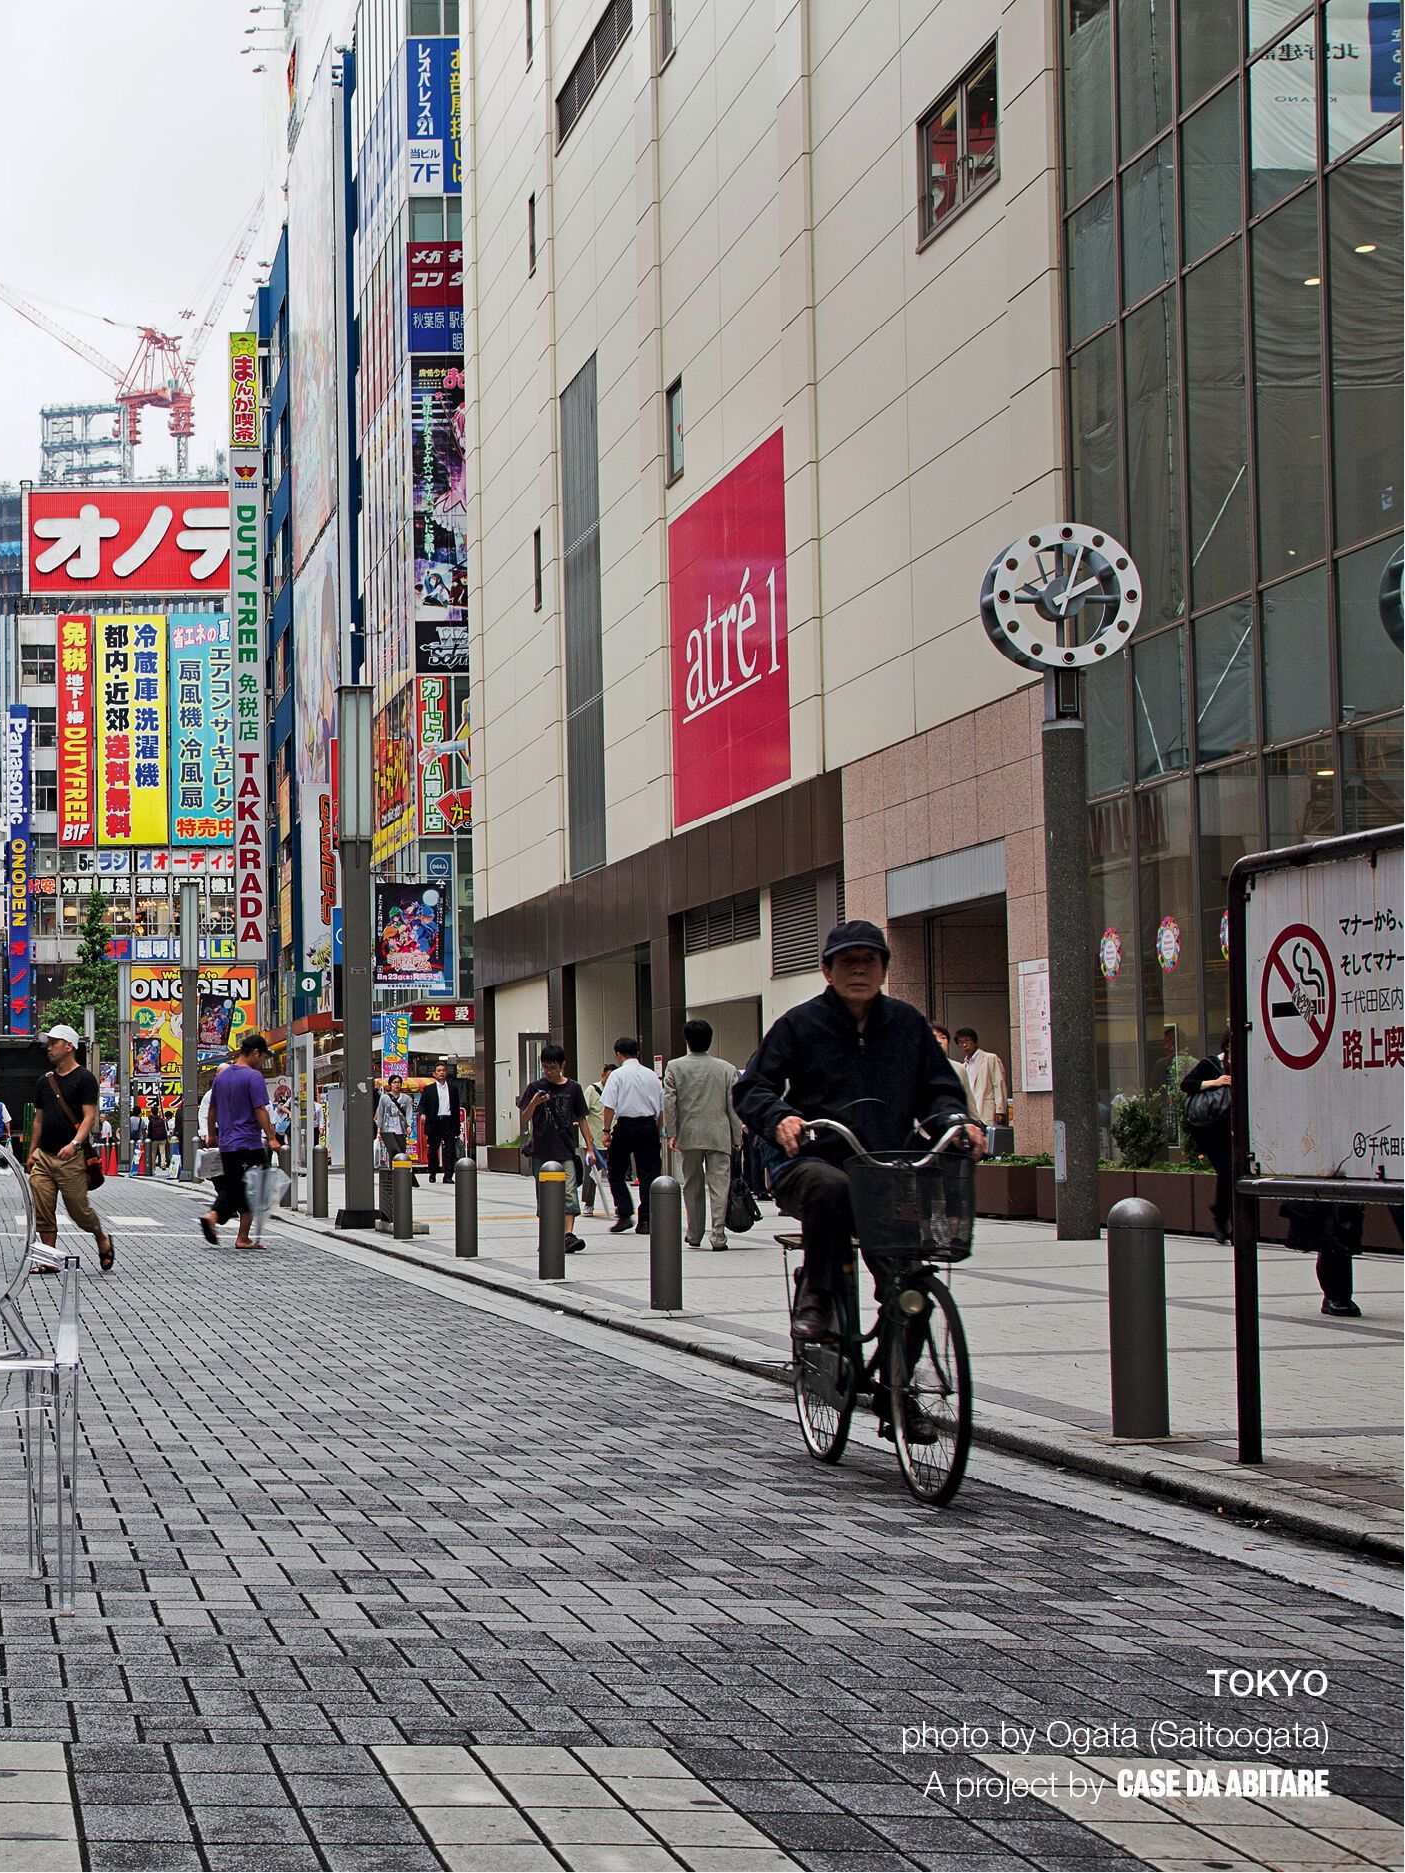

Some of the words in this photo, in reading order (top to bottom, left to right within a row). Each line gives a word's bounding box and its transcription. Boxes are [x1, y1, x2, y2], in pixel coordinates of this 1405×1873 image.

[416, 43, 434, 136] レオパレス21
[410, 149, 440, 159] 当ビル
[410, 163, 440, 184] 7F
[234, 356, 255, 442] まんが喫茶
[236, 505, 257, 582] DUTY
[62, 622, 88, 673] 免税
[172, 618, 230, 650] 省エネの夏
[238, 592, 258, 663] FREE
[686, 567, 758, 714] atré
[768, 567, 781, 676] 1
[178, 659, 204, 809] 扇風機・冷風扇
[238, 673, 259, 741] 免税店
[9, 717, 28, 825] Panasonic
[63, 727, 88, 823] DUTYFREE
[62, 824, 91, 842] B1F
[79, 853, 94, 872] 5F
[176, 818, 234, 838] 特売中
[237, 753, 264, 943] TAKARADA
[11, 839, 27, 926] ONODEN
[425, 1006, 441, 1021] 光
[454, 1006, 470, 1021] 愛
